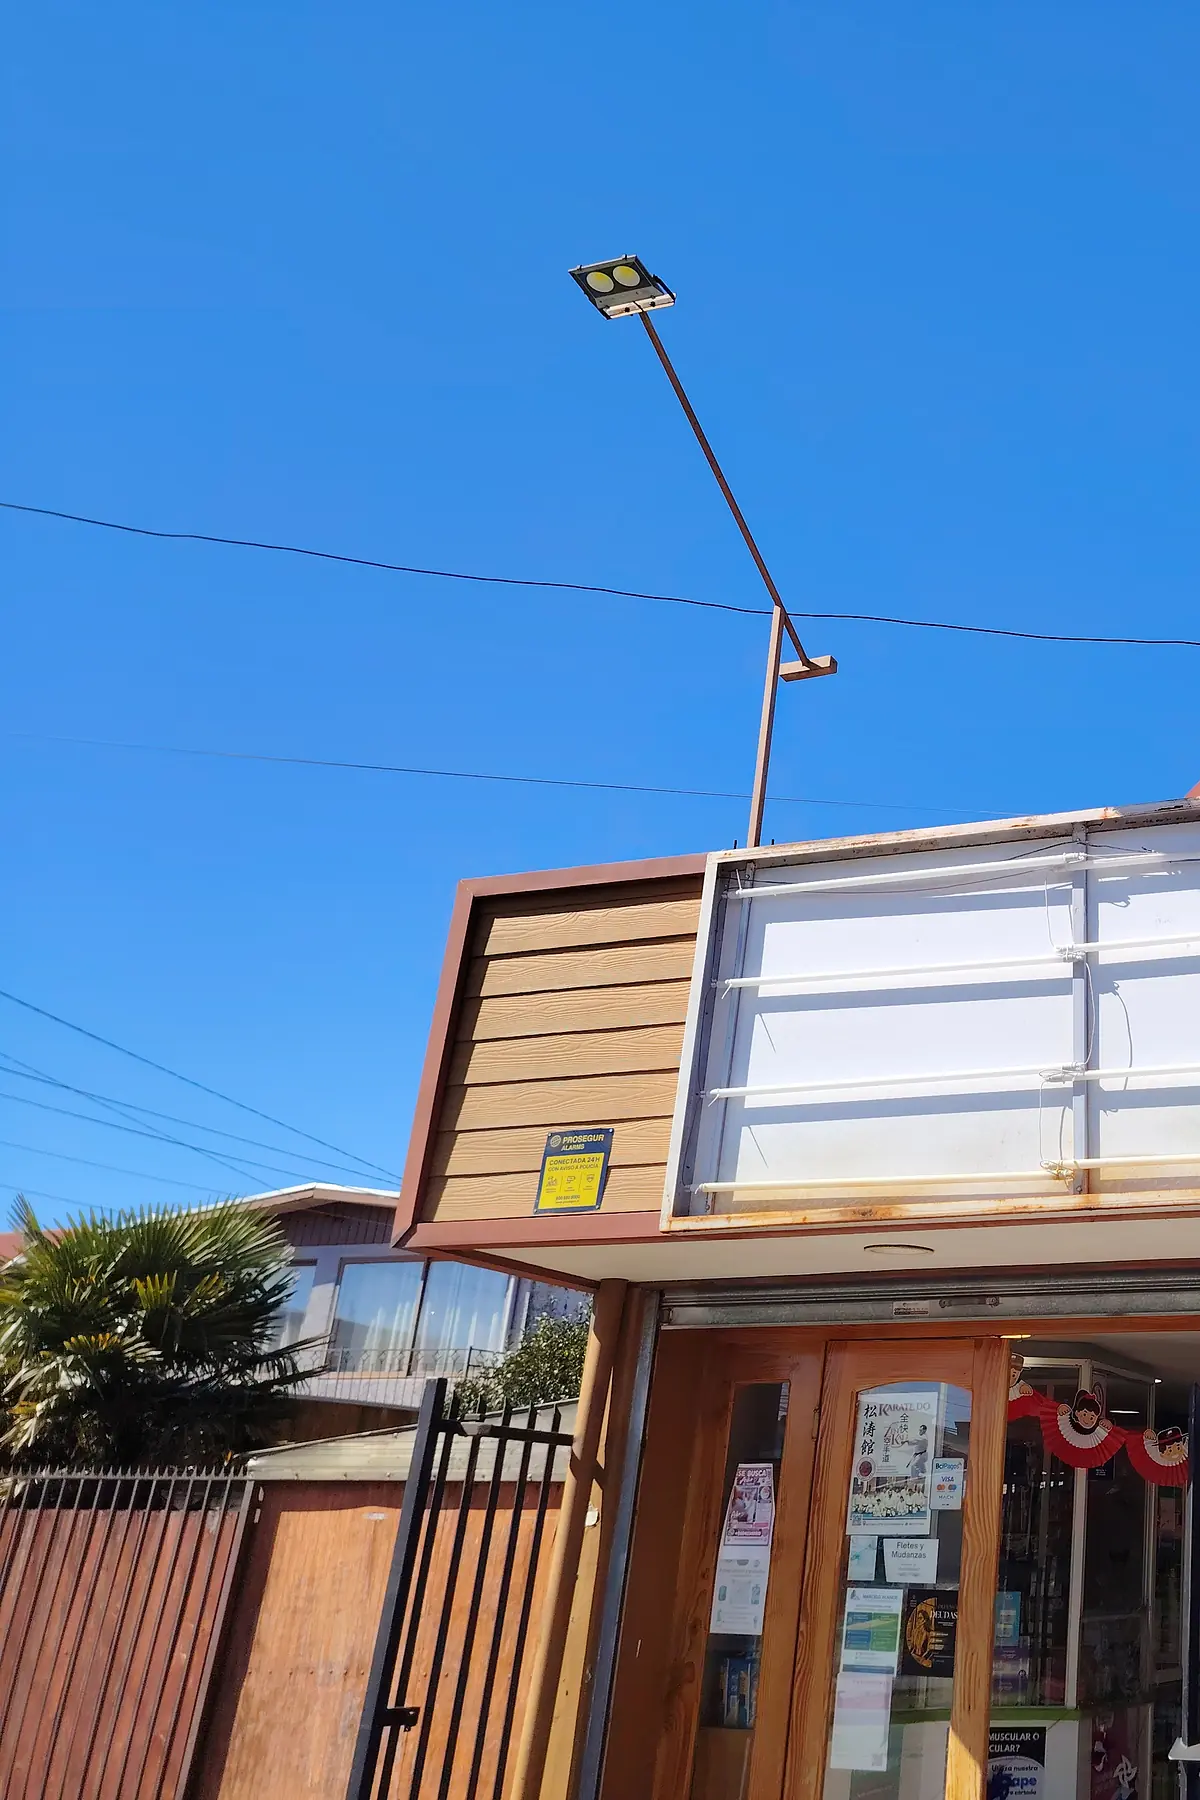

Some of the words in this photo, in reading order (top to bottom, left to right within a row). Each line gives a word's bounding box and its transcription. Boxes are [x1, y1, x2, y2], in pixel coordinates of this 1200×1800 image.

[562, 1134, 605, 1143] PROSEGUR
[896, 1541, 918, 1550] Fletes
[891, 1550, 927, 1559] Mudanzas
[929, 1610, 958, 1620] DEUDAS
[989, 1732, 1031, 1741] MUSCULAR
[1013, 1764, 1039, 1772] nuestra
